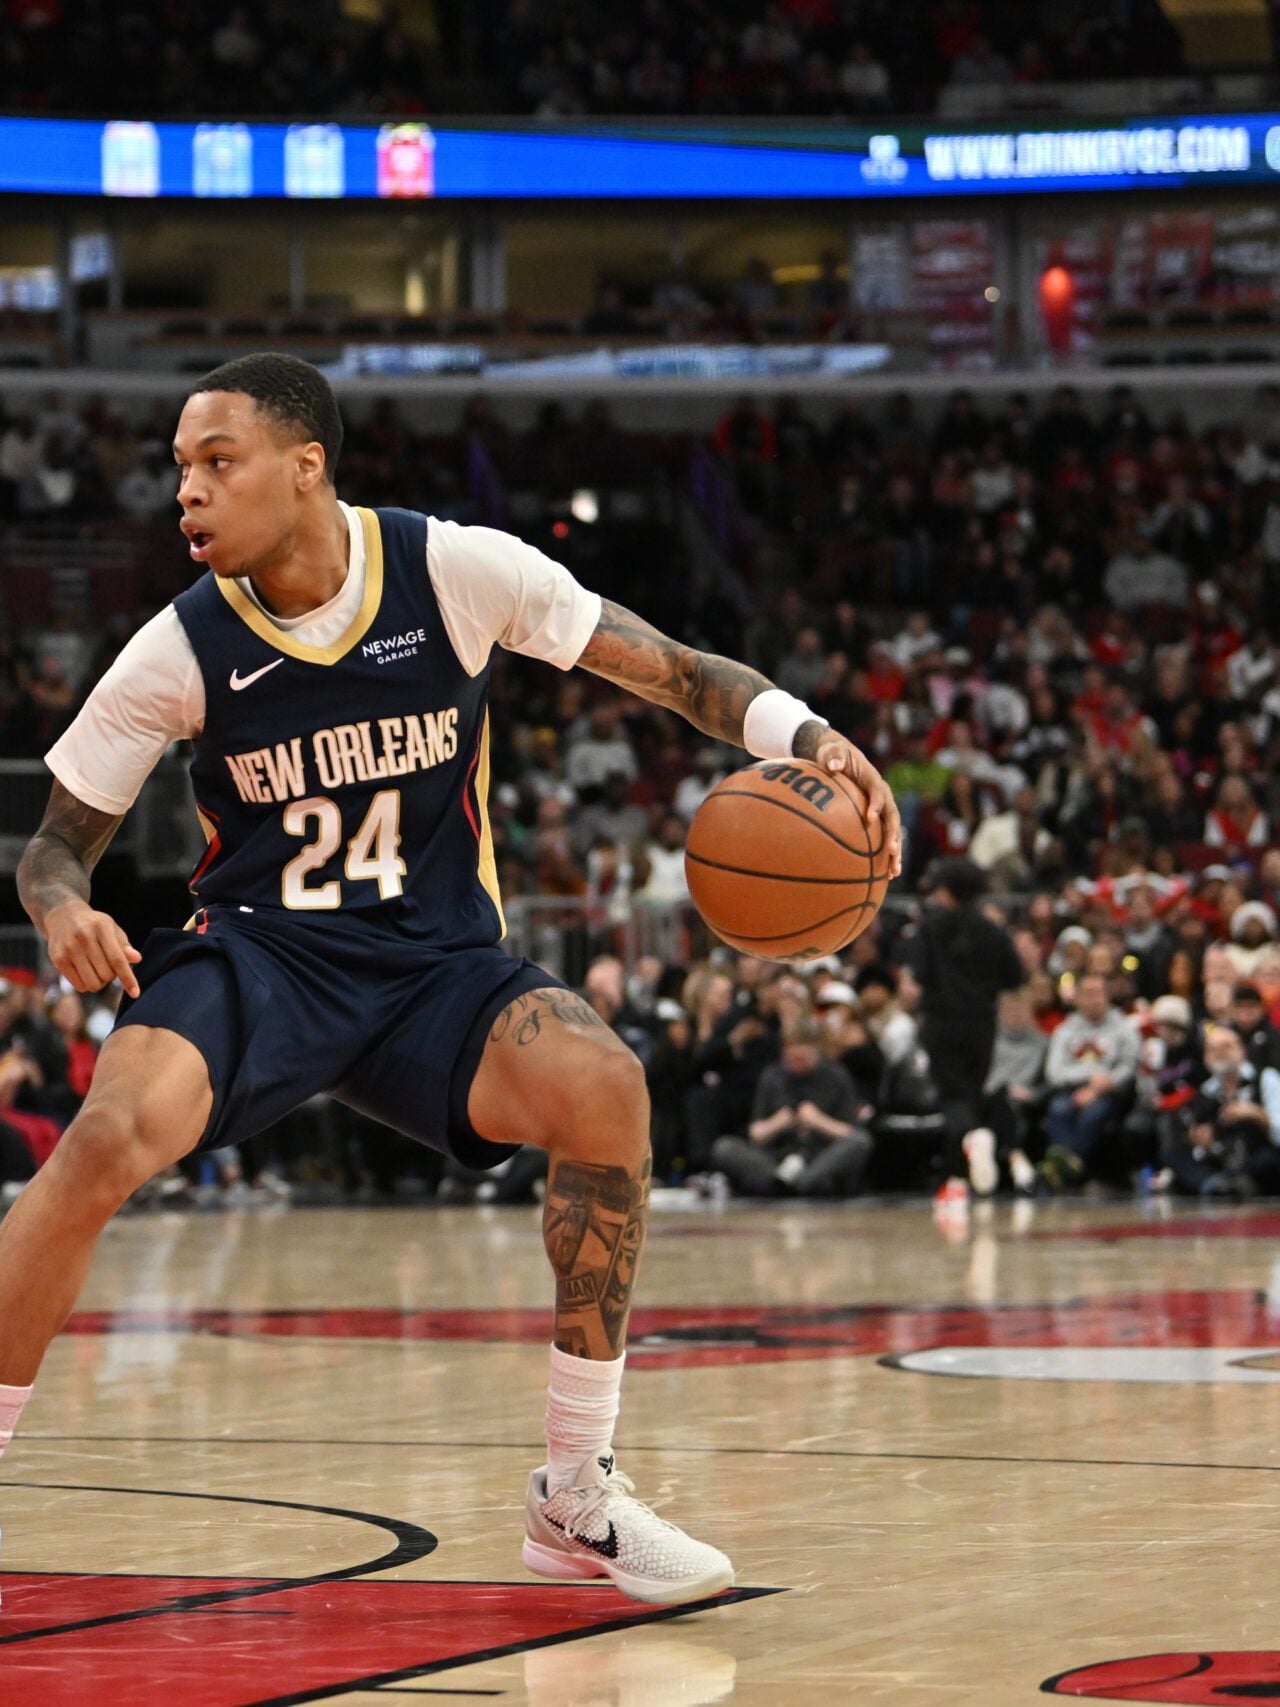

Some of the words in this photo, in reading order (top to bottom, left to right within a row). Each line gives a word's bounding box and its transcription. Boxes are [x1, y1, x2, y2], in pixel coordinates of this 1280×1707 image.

[362, 628, 427, 658] NEWAGE
[377, 646, 418, 665] GARAGE
[224, 737, 307, 804] NEW
[312, 706, 459, 790] ORLEANS
[281, 788, 408, 910] 24
